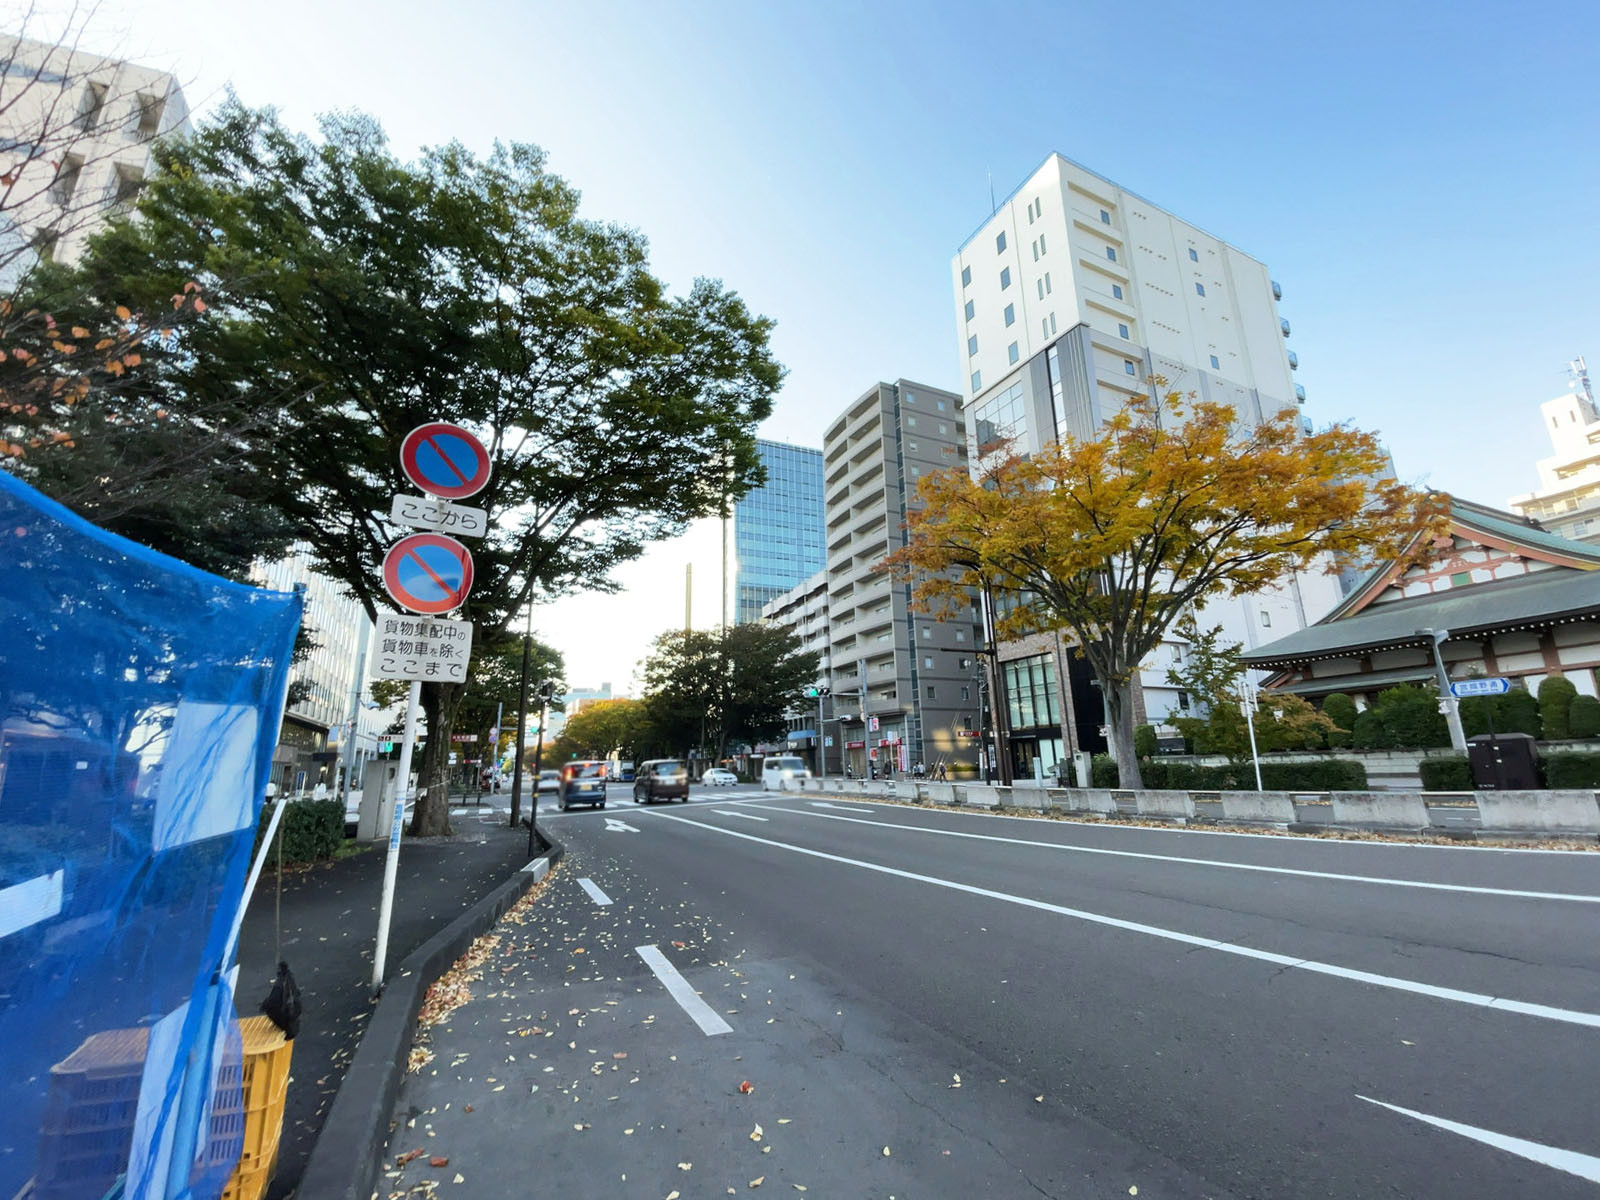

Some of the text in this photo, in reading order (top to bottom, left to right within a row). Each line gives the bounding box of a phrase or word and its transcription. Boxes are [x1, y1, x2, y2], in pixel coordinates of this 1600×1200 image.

[401, 503, 478, 529] ここから
[383, 619, 466, 640] 貨物集配中の
[381, 638, 464, 659] 貨物車を除く
[380, 658, 463, 677] ここまで
